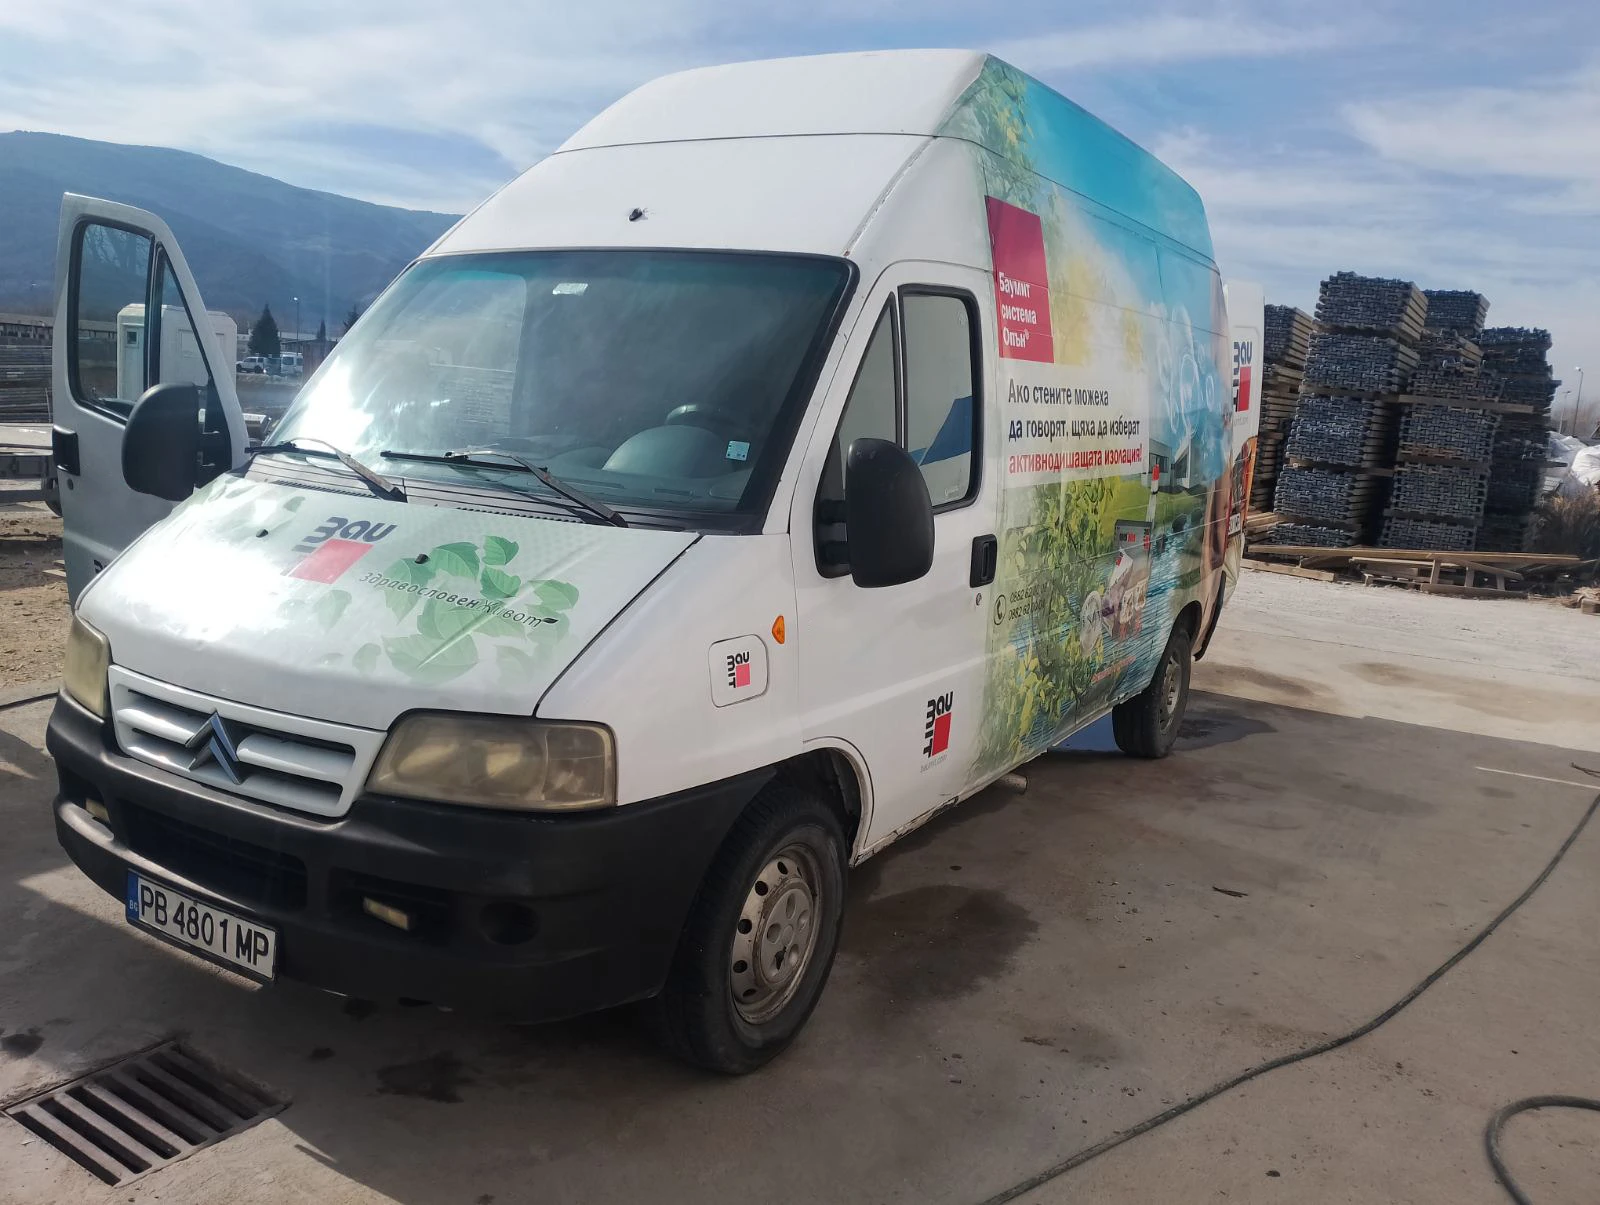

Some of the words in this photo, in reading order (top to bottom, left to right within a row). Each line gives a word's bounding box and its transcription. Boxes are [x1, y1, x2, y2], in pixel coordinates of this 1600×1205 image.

[999, 271, 1031, 298] Баумит
[1001, 303, 1037, 325] система
[1008, 378, 1030, 403] Ако
[1032, 385, 1072, 405] стените
[1074, 388, 1109, 406] можеха
[1008, 420, 1023, 442] да
[1071, 421, 1095, 440] щяха
[1097, 421, 1108, 440] да
[1109, 415, 1141, 439] изберат
[129, 900, 138, 912] BG
[140, 884, 168, 926] PB
[172, 901, 229, 954] 4801
[235, 924, 270, 966] MP
